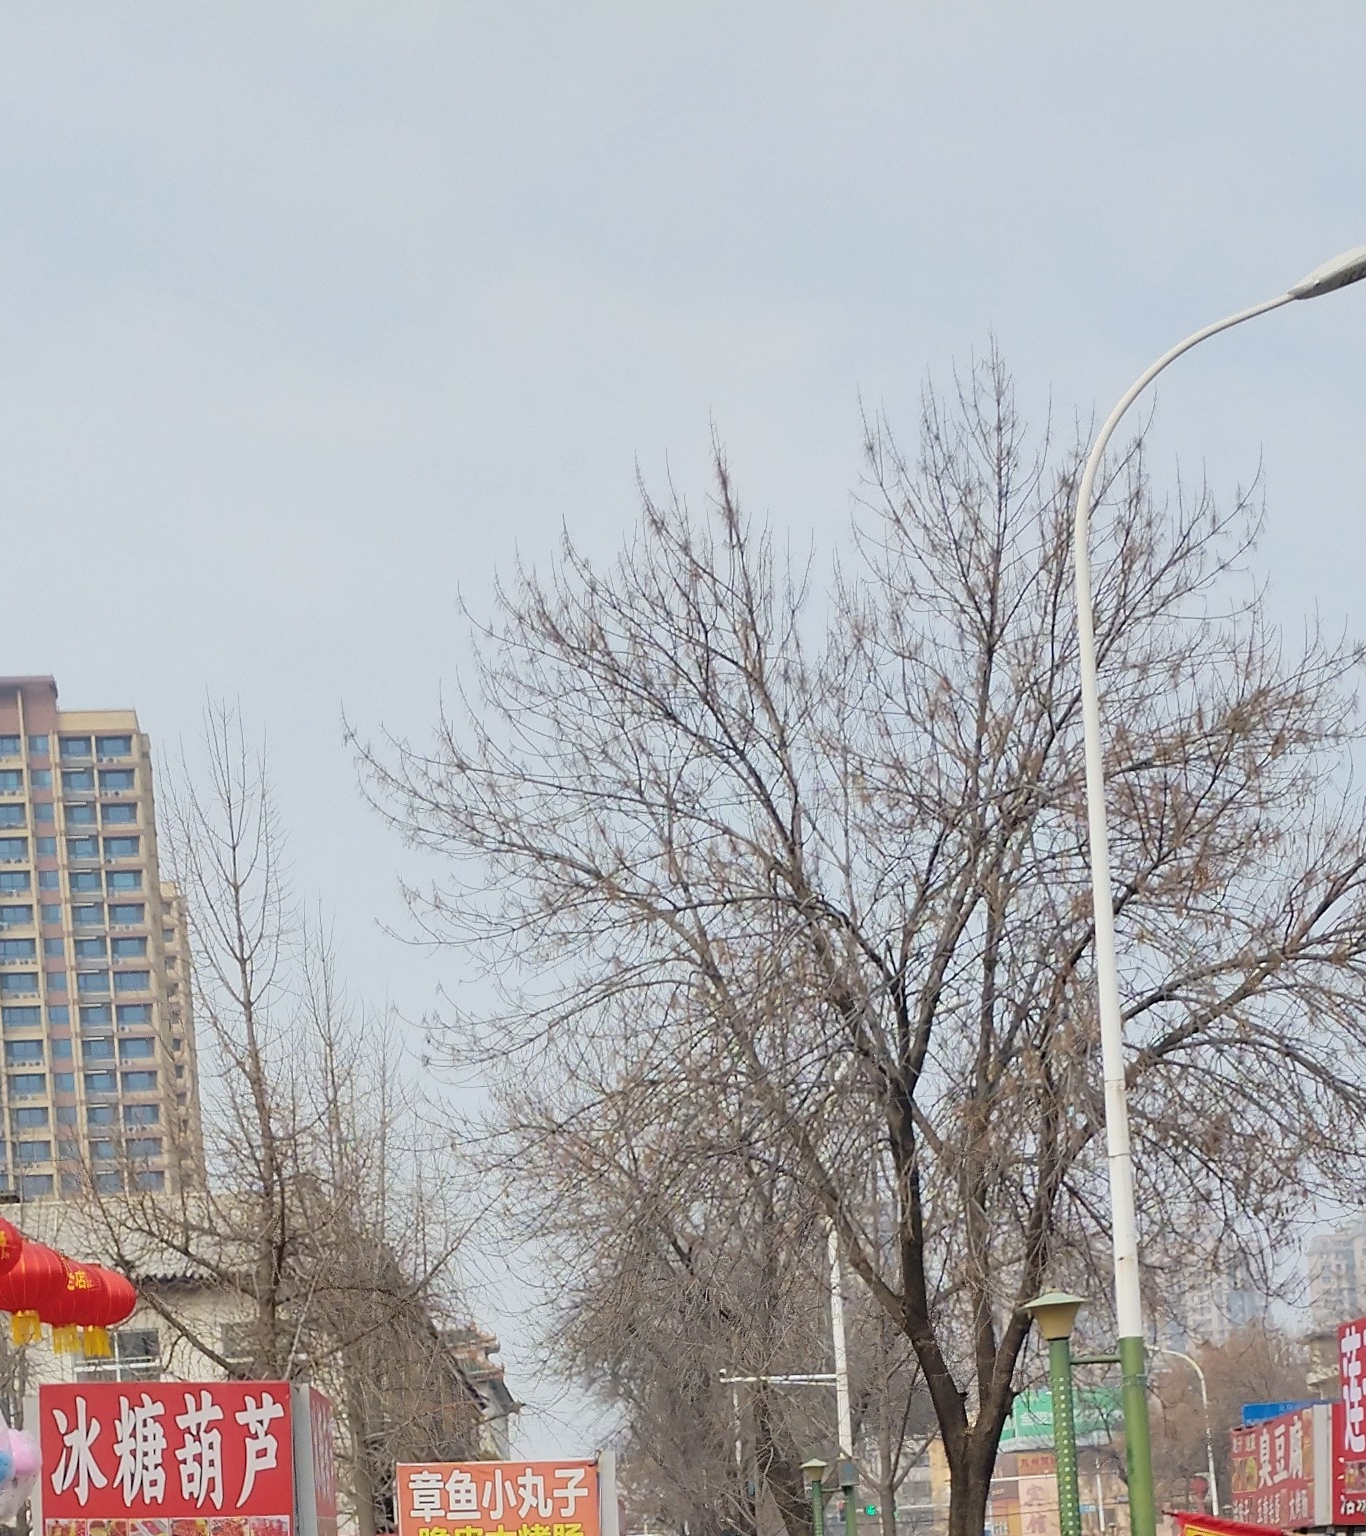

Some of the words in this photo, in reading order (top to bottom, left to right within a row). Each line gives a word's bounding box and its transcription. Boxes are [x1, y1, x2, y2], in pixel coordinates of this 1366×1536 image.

[50, 1389, 287, 1511] 冰糖葫芦
[1257, 1414, 1304, 1490] 臭豆腐
[408, 1467, 590, 1523] 章鱼小丸子
